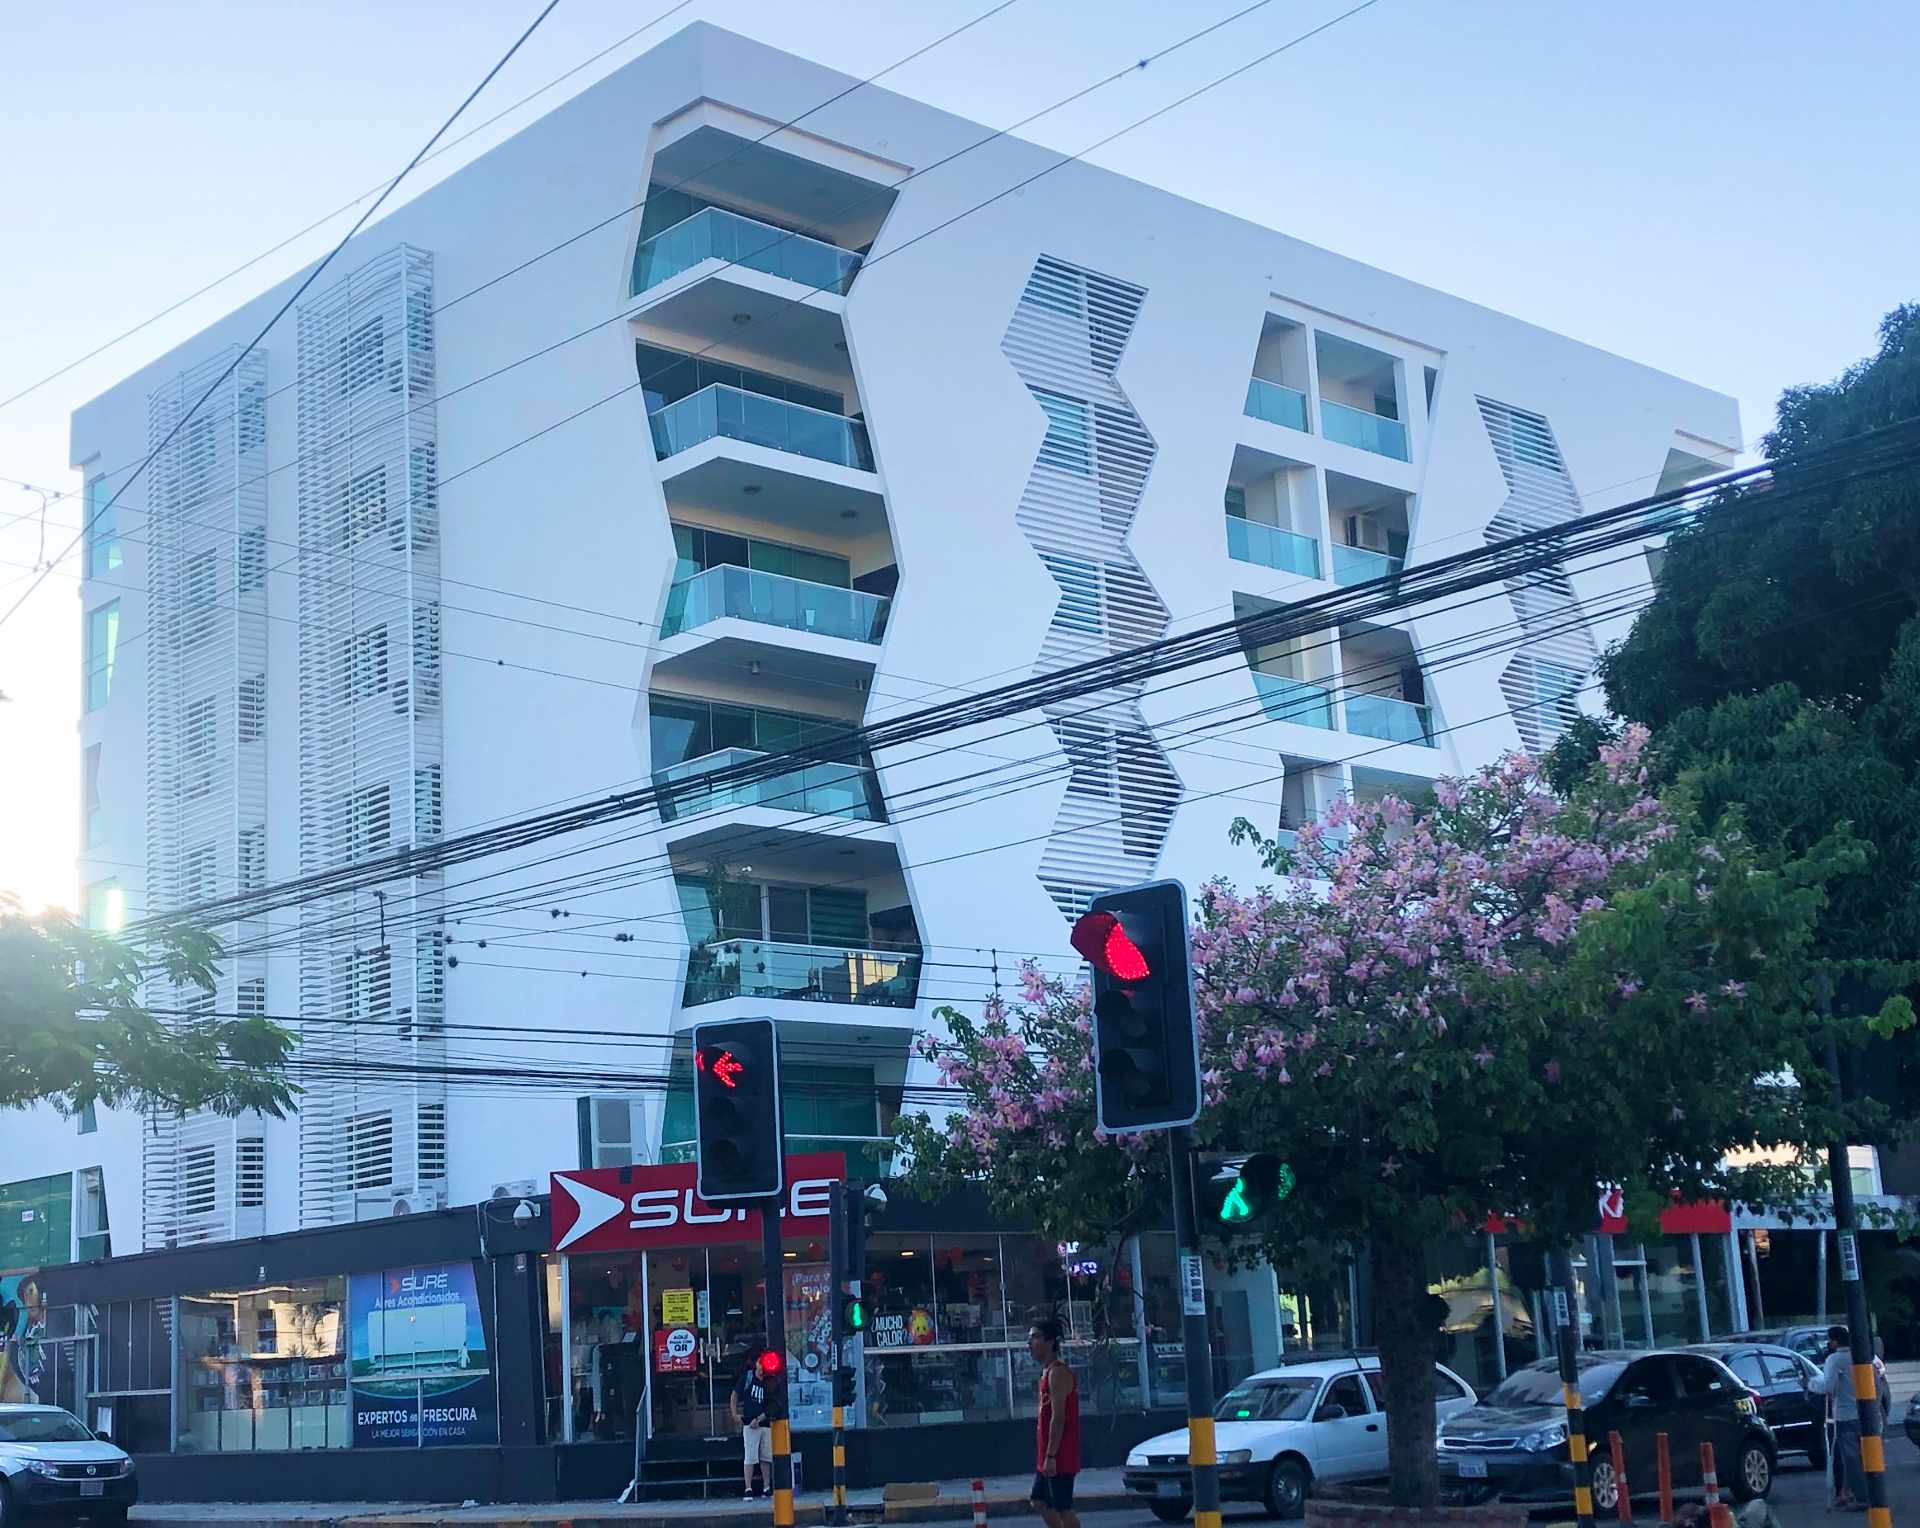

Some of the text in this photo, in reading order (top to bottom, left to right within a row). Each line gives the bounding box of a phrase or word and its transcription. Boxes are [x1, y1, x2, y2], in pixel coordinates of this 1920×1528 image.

[630, 1178, 840, 1229] SUE
[401, 1273, 449, 1291] SURE
[374, 1290, 460, 1309] Aires Acondicionados
[674, 1344, 688, 1352] QR
[358, 1409, 408, 1425] EXPERTOS
[423, 1406, 477, 1422] FRESCURA
